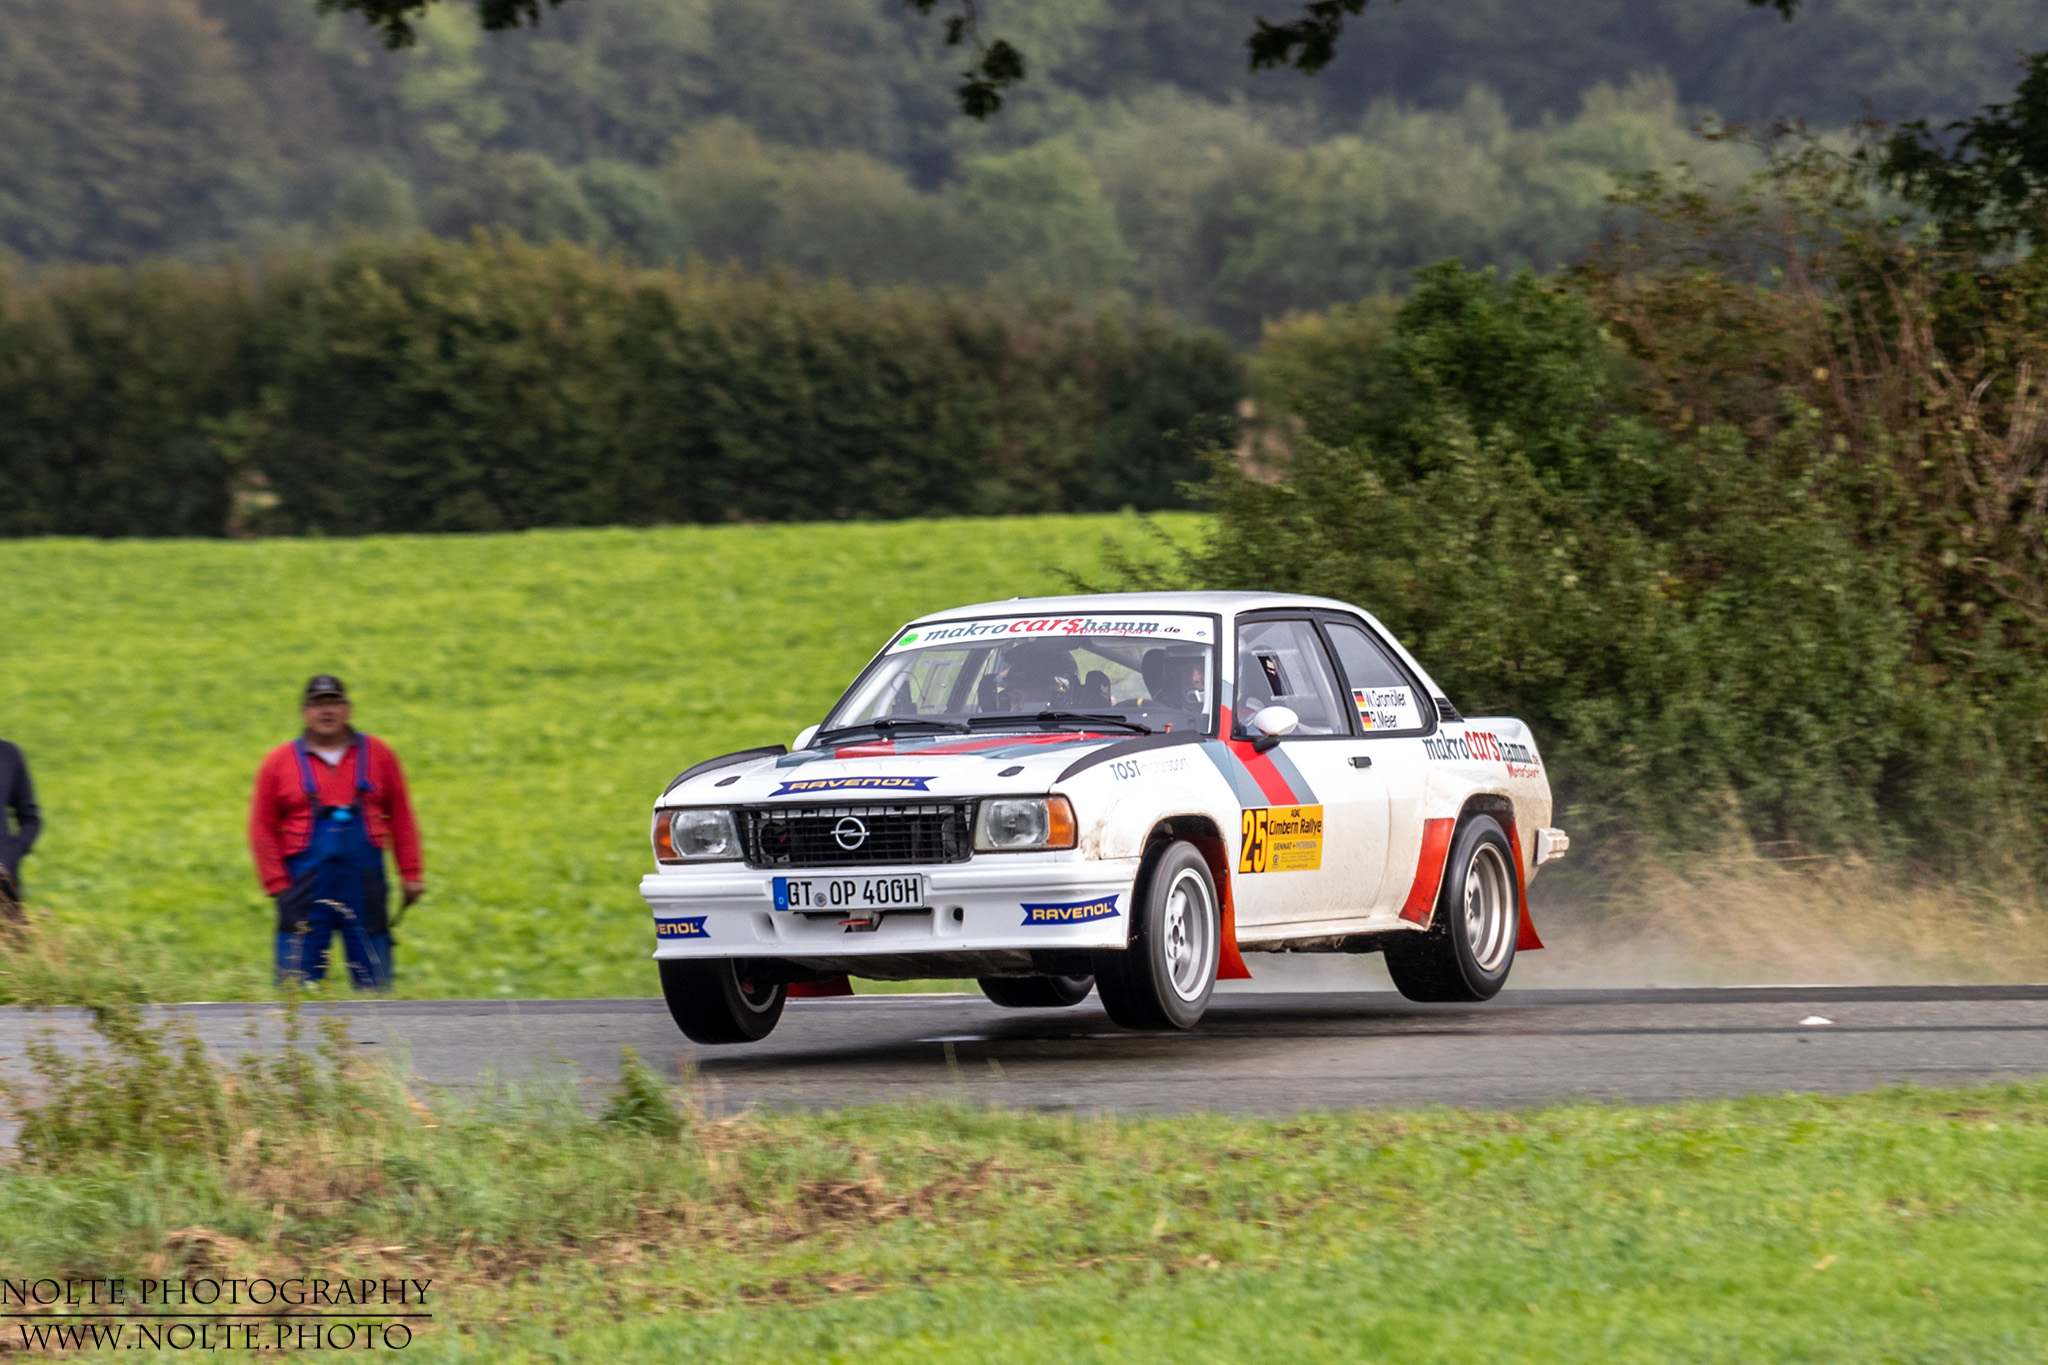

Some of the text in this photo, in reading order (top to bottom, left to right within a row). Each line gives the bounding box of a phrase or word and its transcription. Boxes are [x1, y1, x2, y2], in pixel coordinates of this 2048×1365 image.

[1109, 760, 1141, 780] TOST
[788, 778, 918, 791] RAVENOL
[1269, 818, 1322, 836] Cimbern Rallye
[1239, 809, 1268, 873] 25
[787, 878, 919, 906] GT OP 400H
[1032, 902, 1112, 920] RAVENOL
